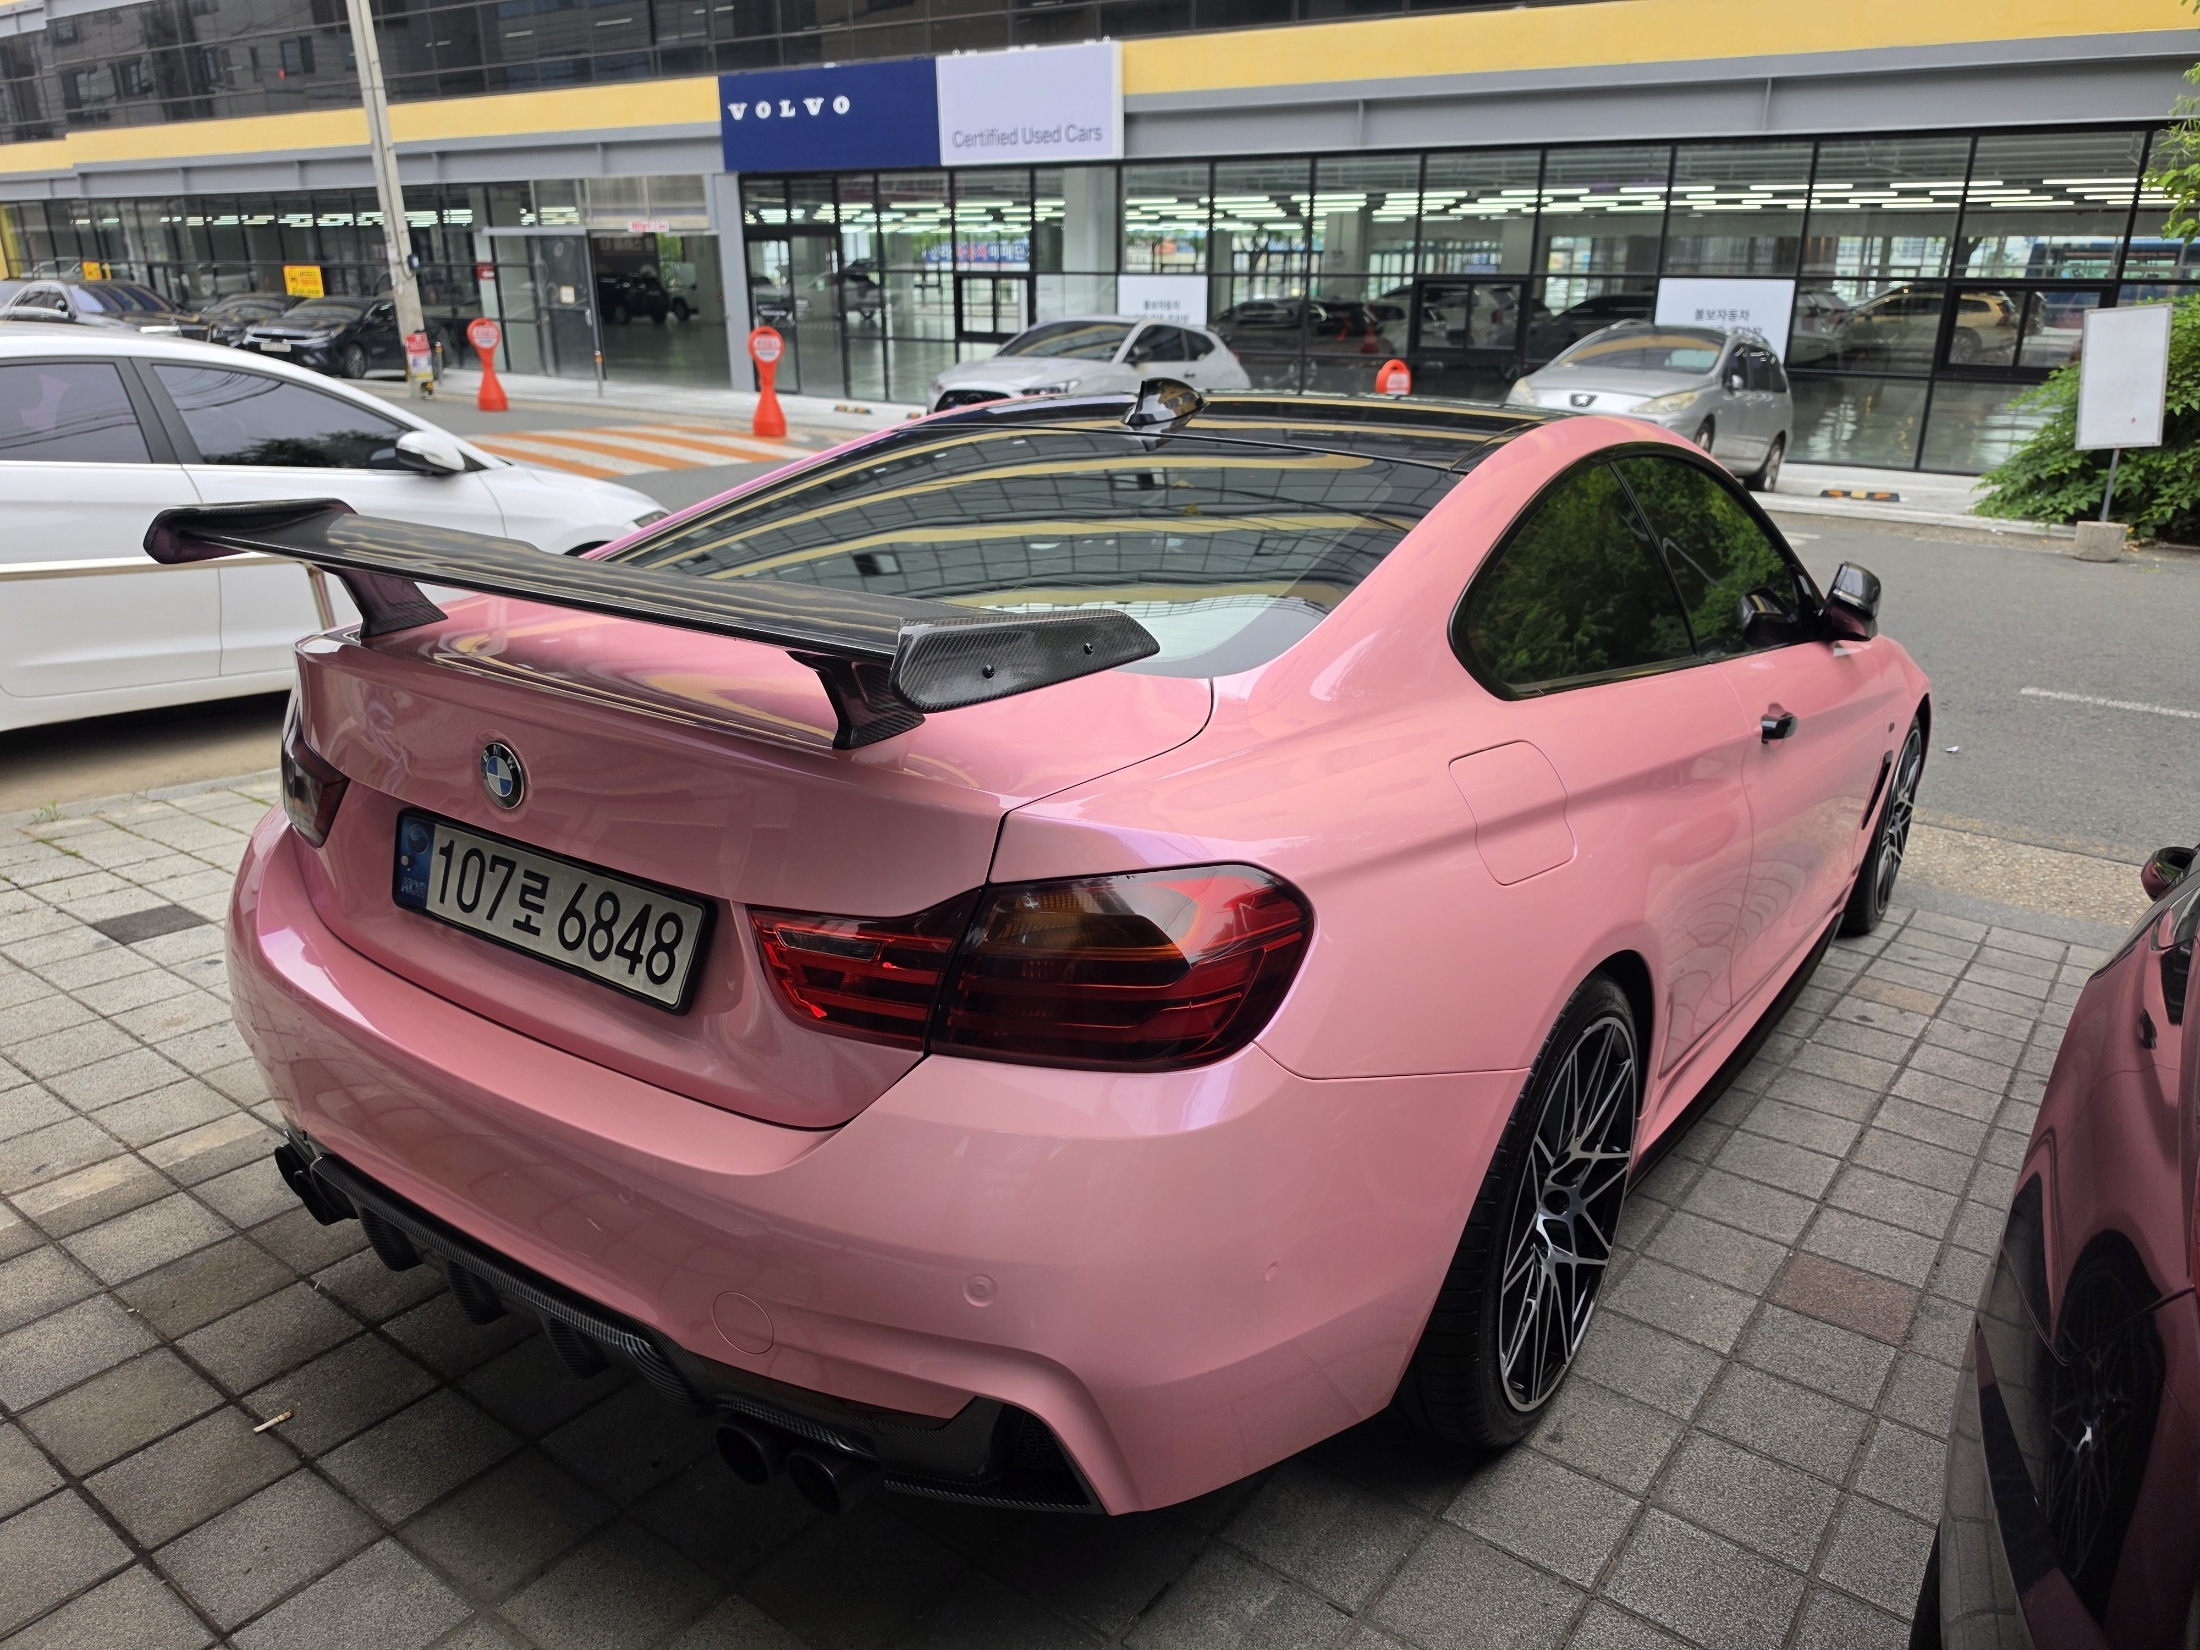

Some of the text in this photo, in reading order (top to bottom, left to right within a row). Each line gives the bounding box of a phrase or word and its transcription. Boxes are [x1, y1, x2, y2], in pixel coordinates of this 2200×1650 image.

[727, 95, 850, 121] VOLVO
[952, 123, 1103, 148] Certified Used Cars
[1694, 308, 1751, 322] 볼보자동차
[482, 744, 516, 770] BMW
[400, 876, 427, 899] KOR
[557, 882, 684, 986] 6848
